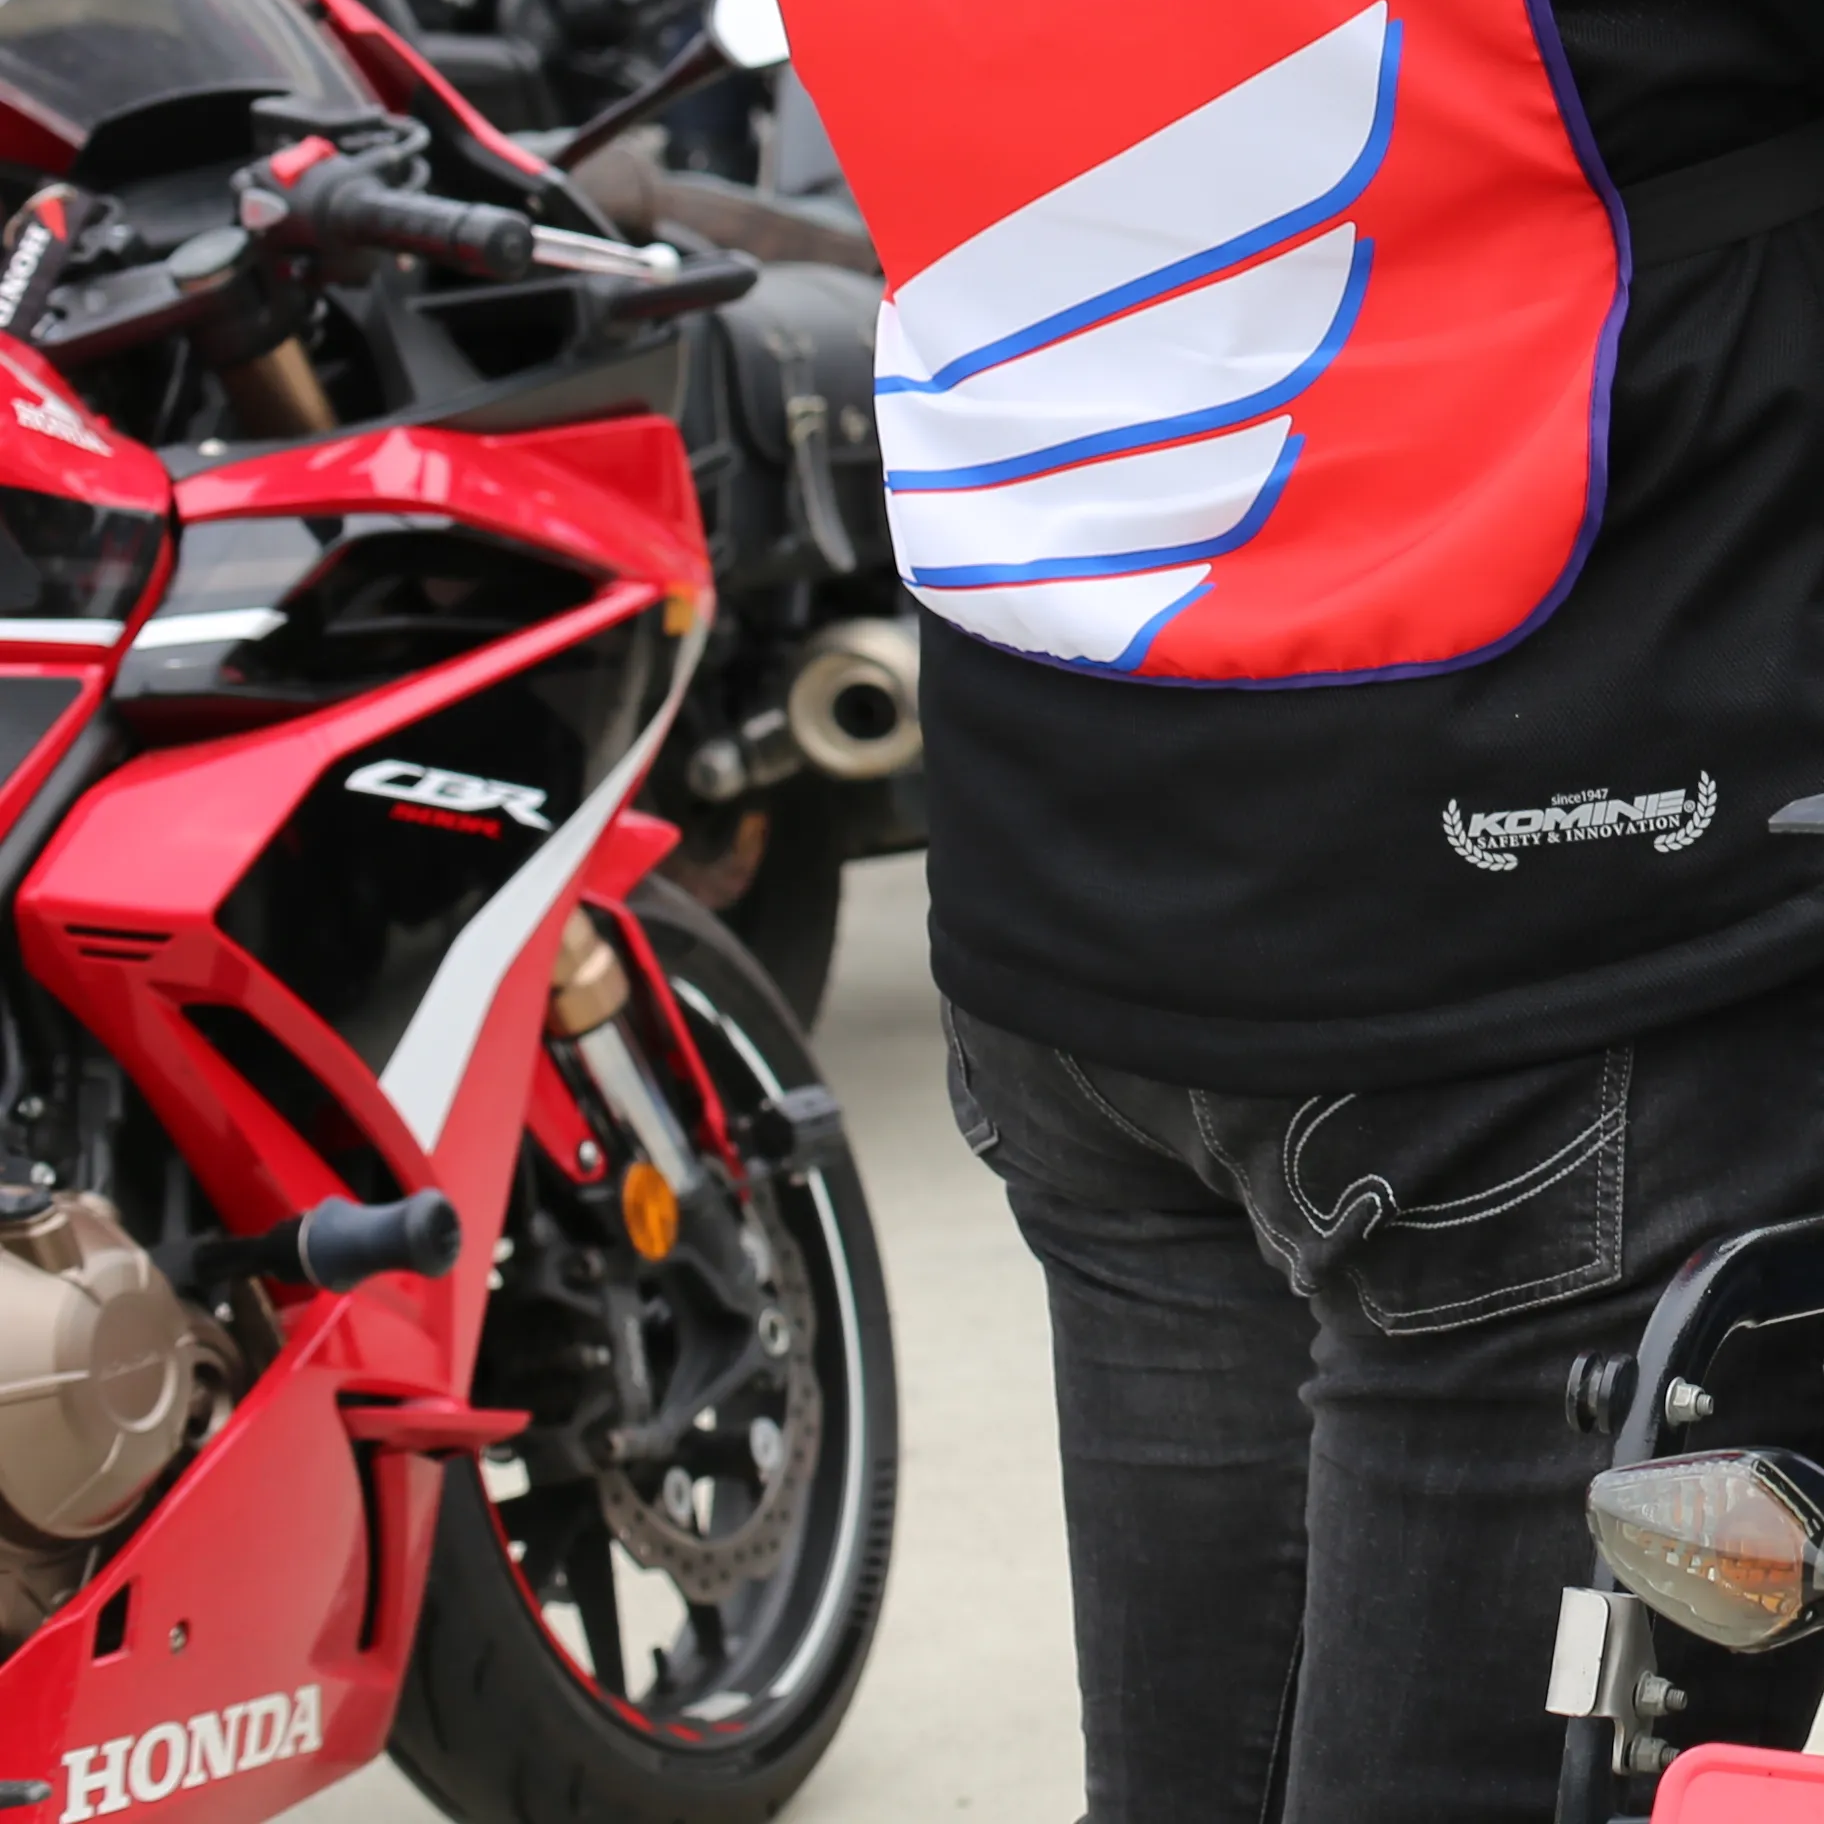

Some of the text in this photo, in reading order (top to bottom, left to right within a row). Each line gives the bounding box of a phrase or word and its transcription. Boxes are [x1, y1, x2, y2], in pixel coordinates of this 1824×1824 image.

[344, 759, 554, 831] CBR
[1467, 789, 1686, 837] KOMINE
[1551, 788, 1609, 806] since1947
[1477, 814, 1681, 849] SAFETY & INNOVATION
[59, 1684, 323, 1824] HONDA
